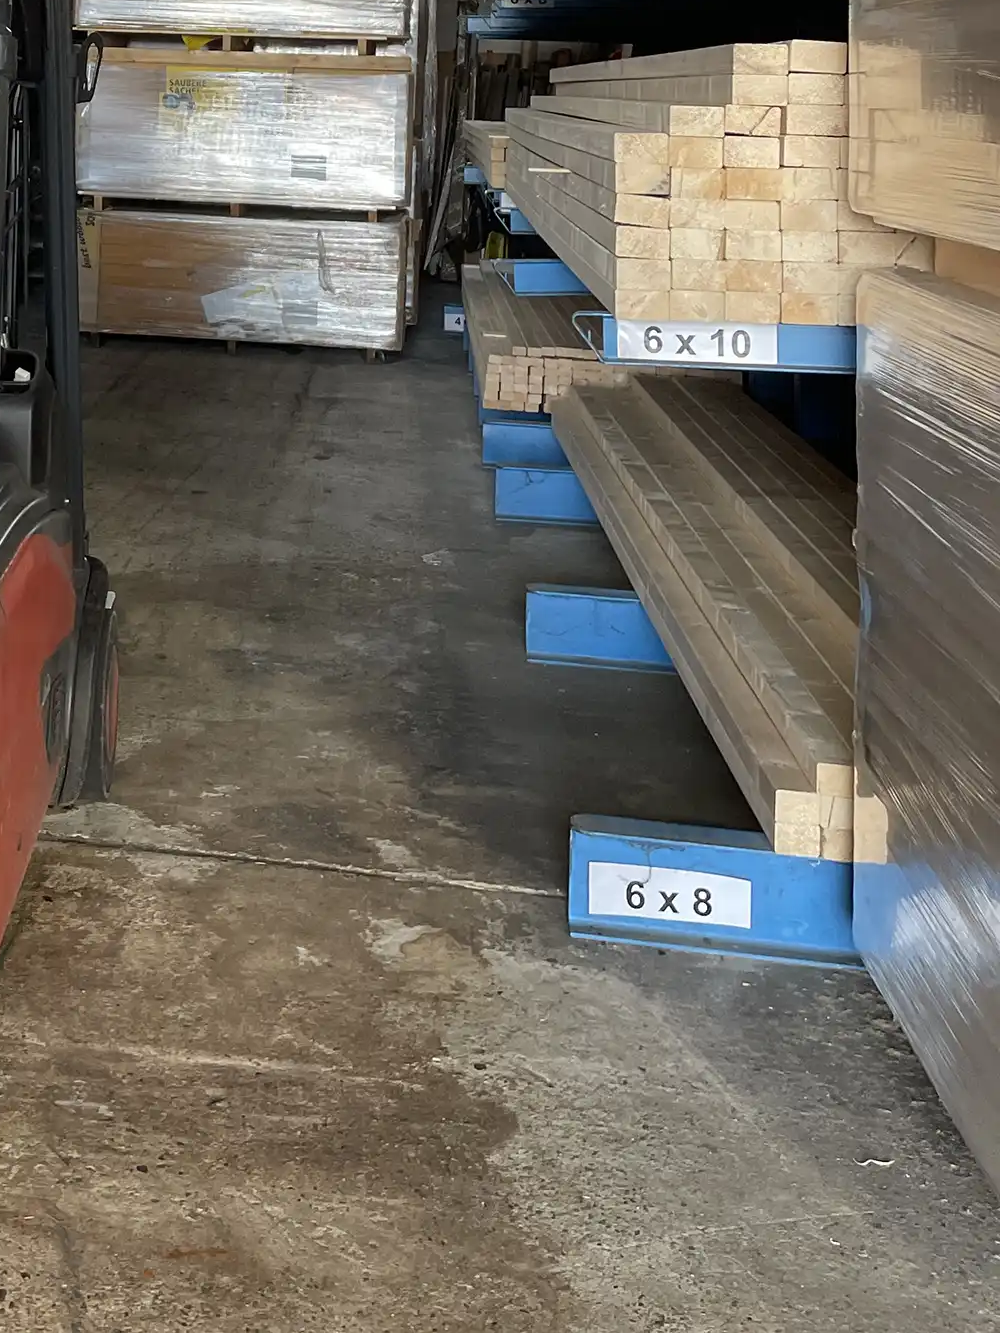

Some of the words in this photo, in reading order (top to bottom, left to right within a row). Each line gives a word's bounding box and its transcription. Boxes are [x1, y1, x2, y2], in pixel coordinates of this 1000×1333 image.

[454, 316, 462, 326] 4
[643, 325, 664, 354] 6
[675, 334, 697, 356] x
[710, 328, 752, 358] 10
[625, 880, 645, 910] 6
[658, 890, 680, 914] x
[692, 887, 713, 917] 8
